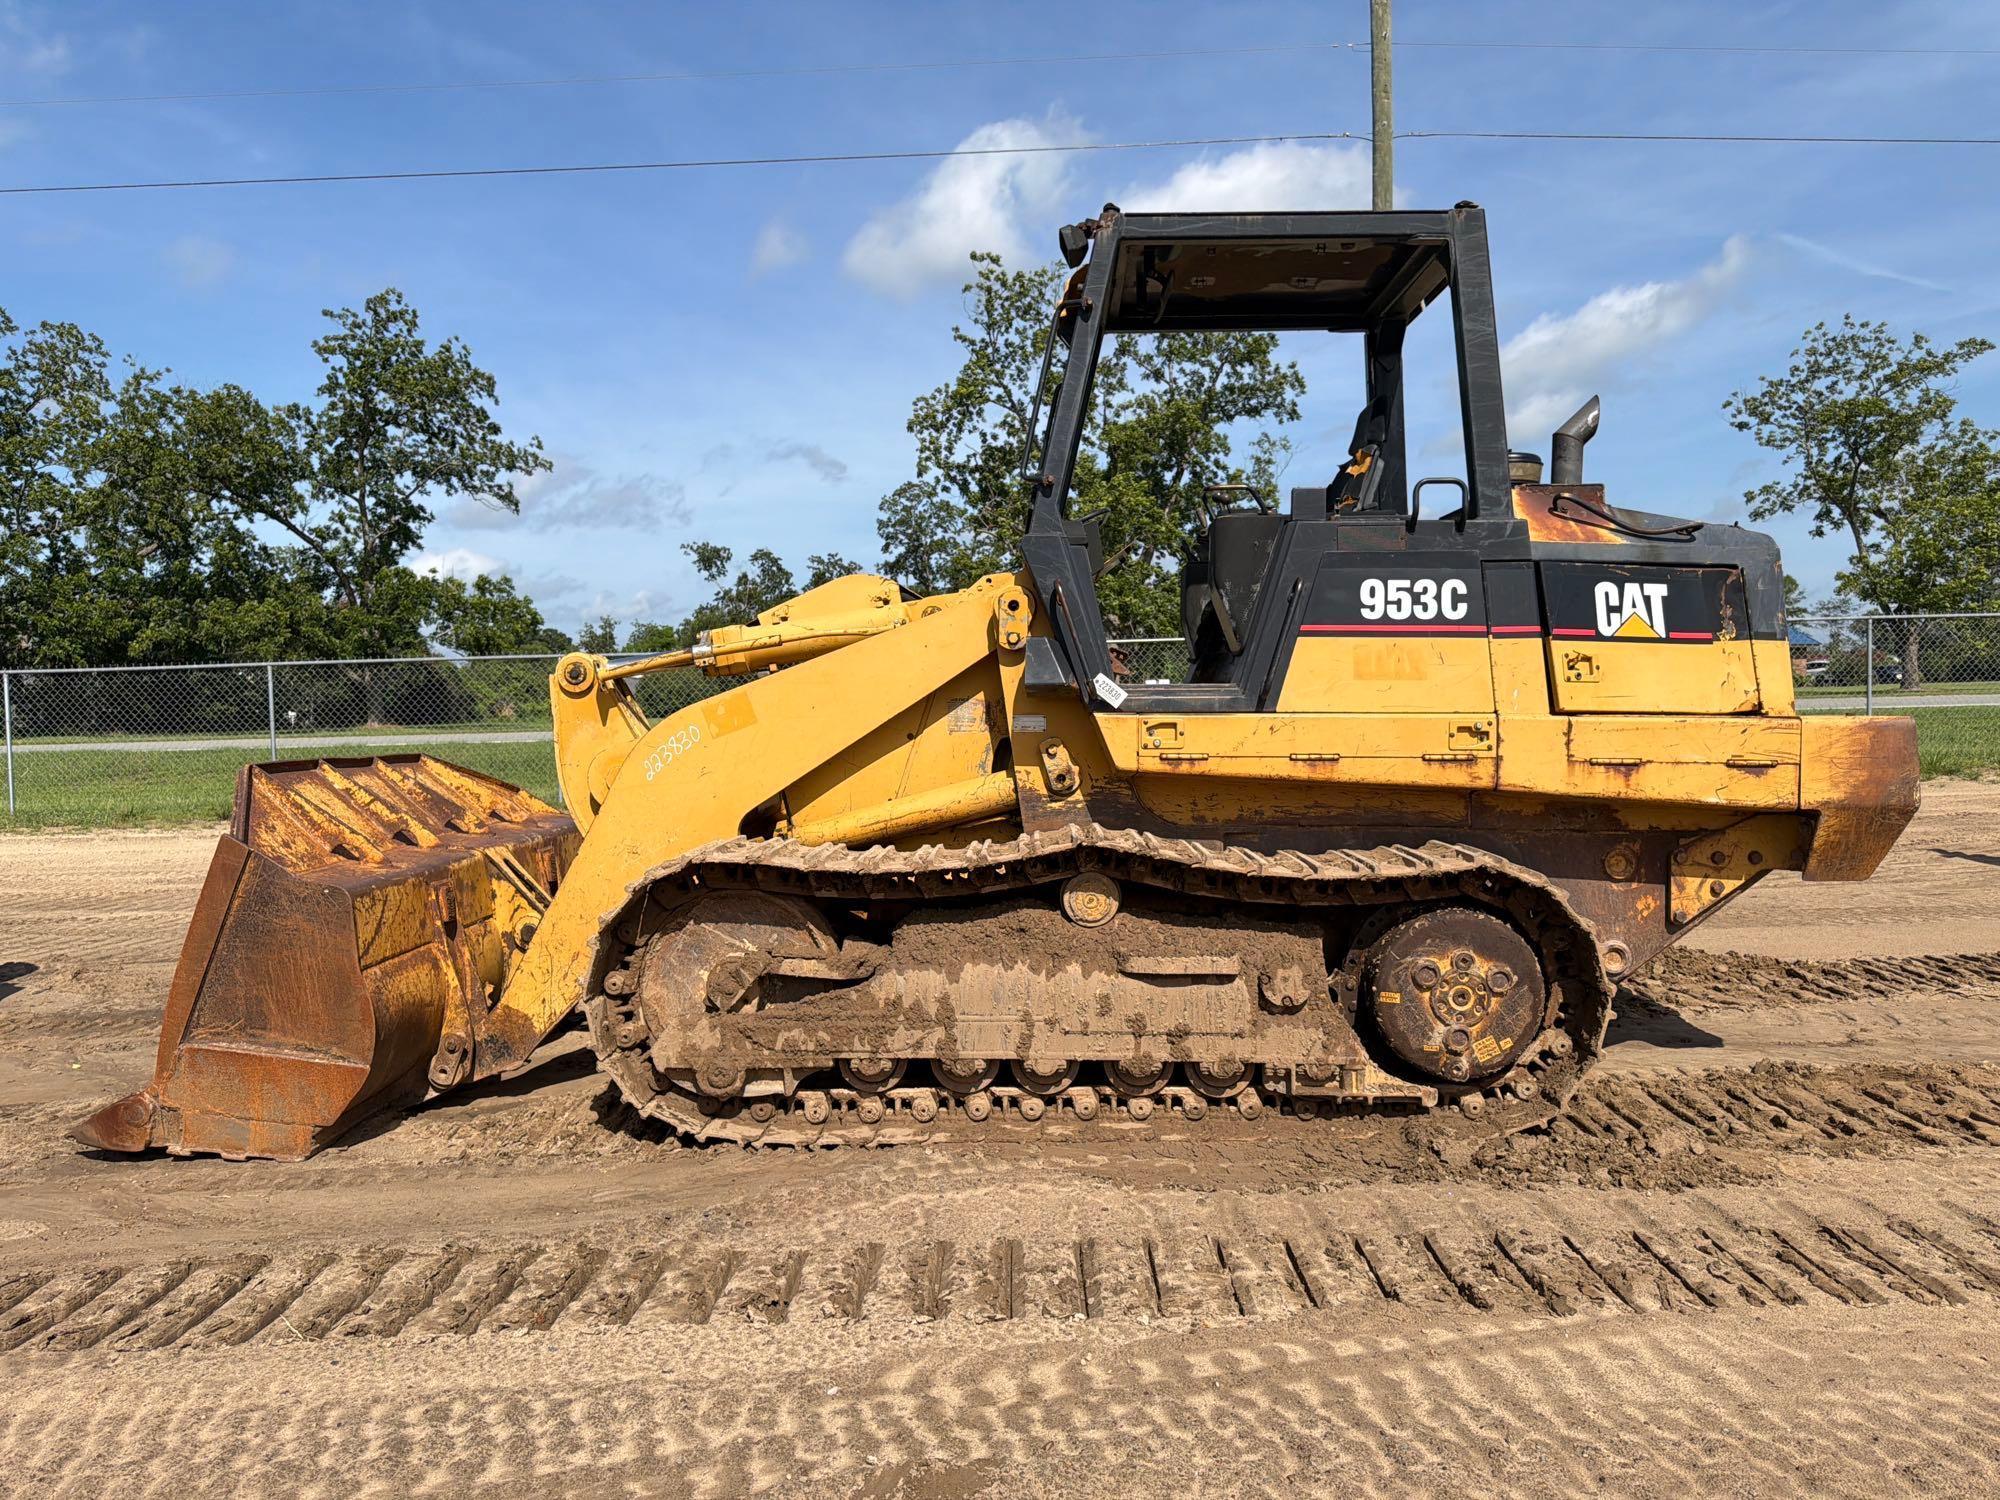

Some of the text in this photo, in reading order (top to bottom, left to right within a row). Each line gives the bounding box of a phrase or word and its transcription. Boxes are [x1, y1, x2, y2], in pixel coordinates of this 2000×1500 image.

[1359, 578, 1468, 620] 953C
[1594, 581, 1669, 638] CAT
[1098, 680, 1122, 701] 223830
[644, 725, 701, 781] 223830
